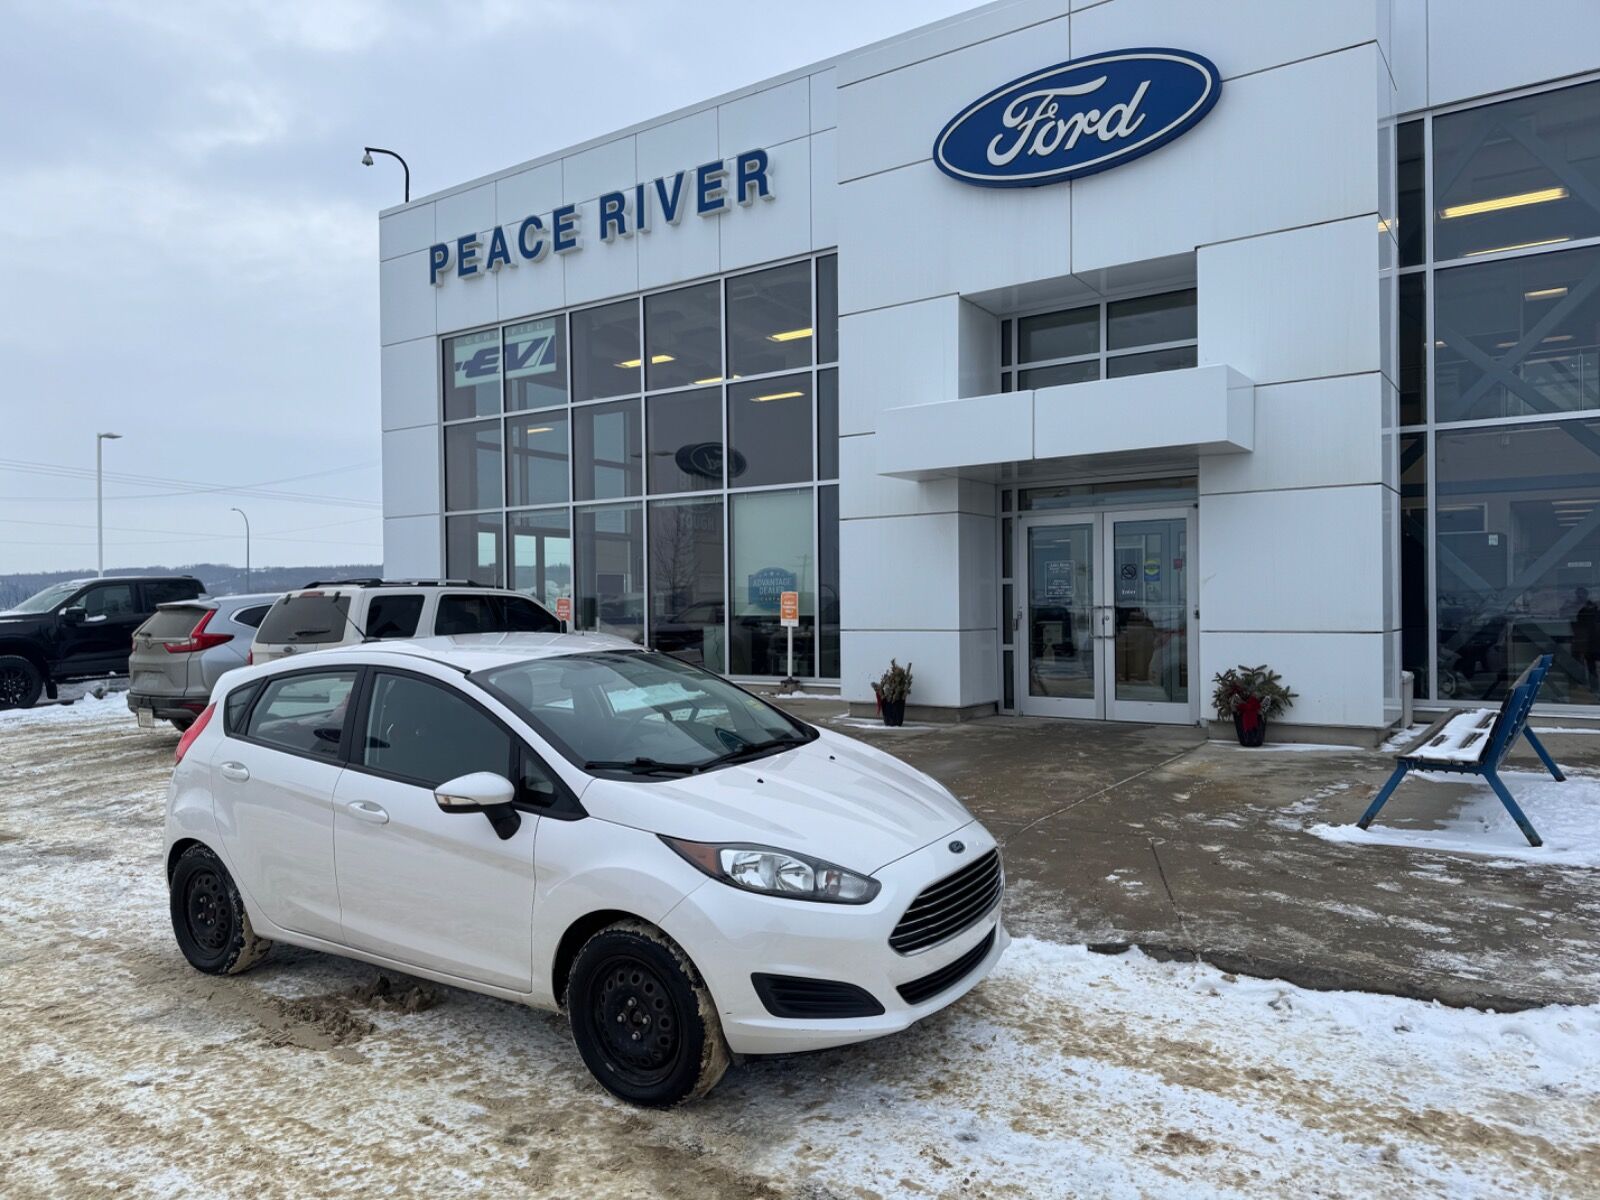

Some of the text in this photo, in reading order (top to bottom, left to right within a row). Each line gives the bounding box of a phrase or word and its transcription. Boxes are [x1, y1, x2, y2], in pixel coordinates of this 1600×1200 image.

[987, 76, 1151, 167] Ford
[430, 148, 775, 286] PEACE RIVER
[753, 577, 793, 587] ADVANTAGE
